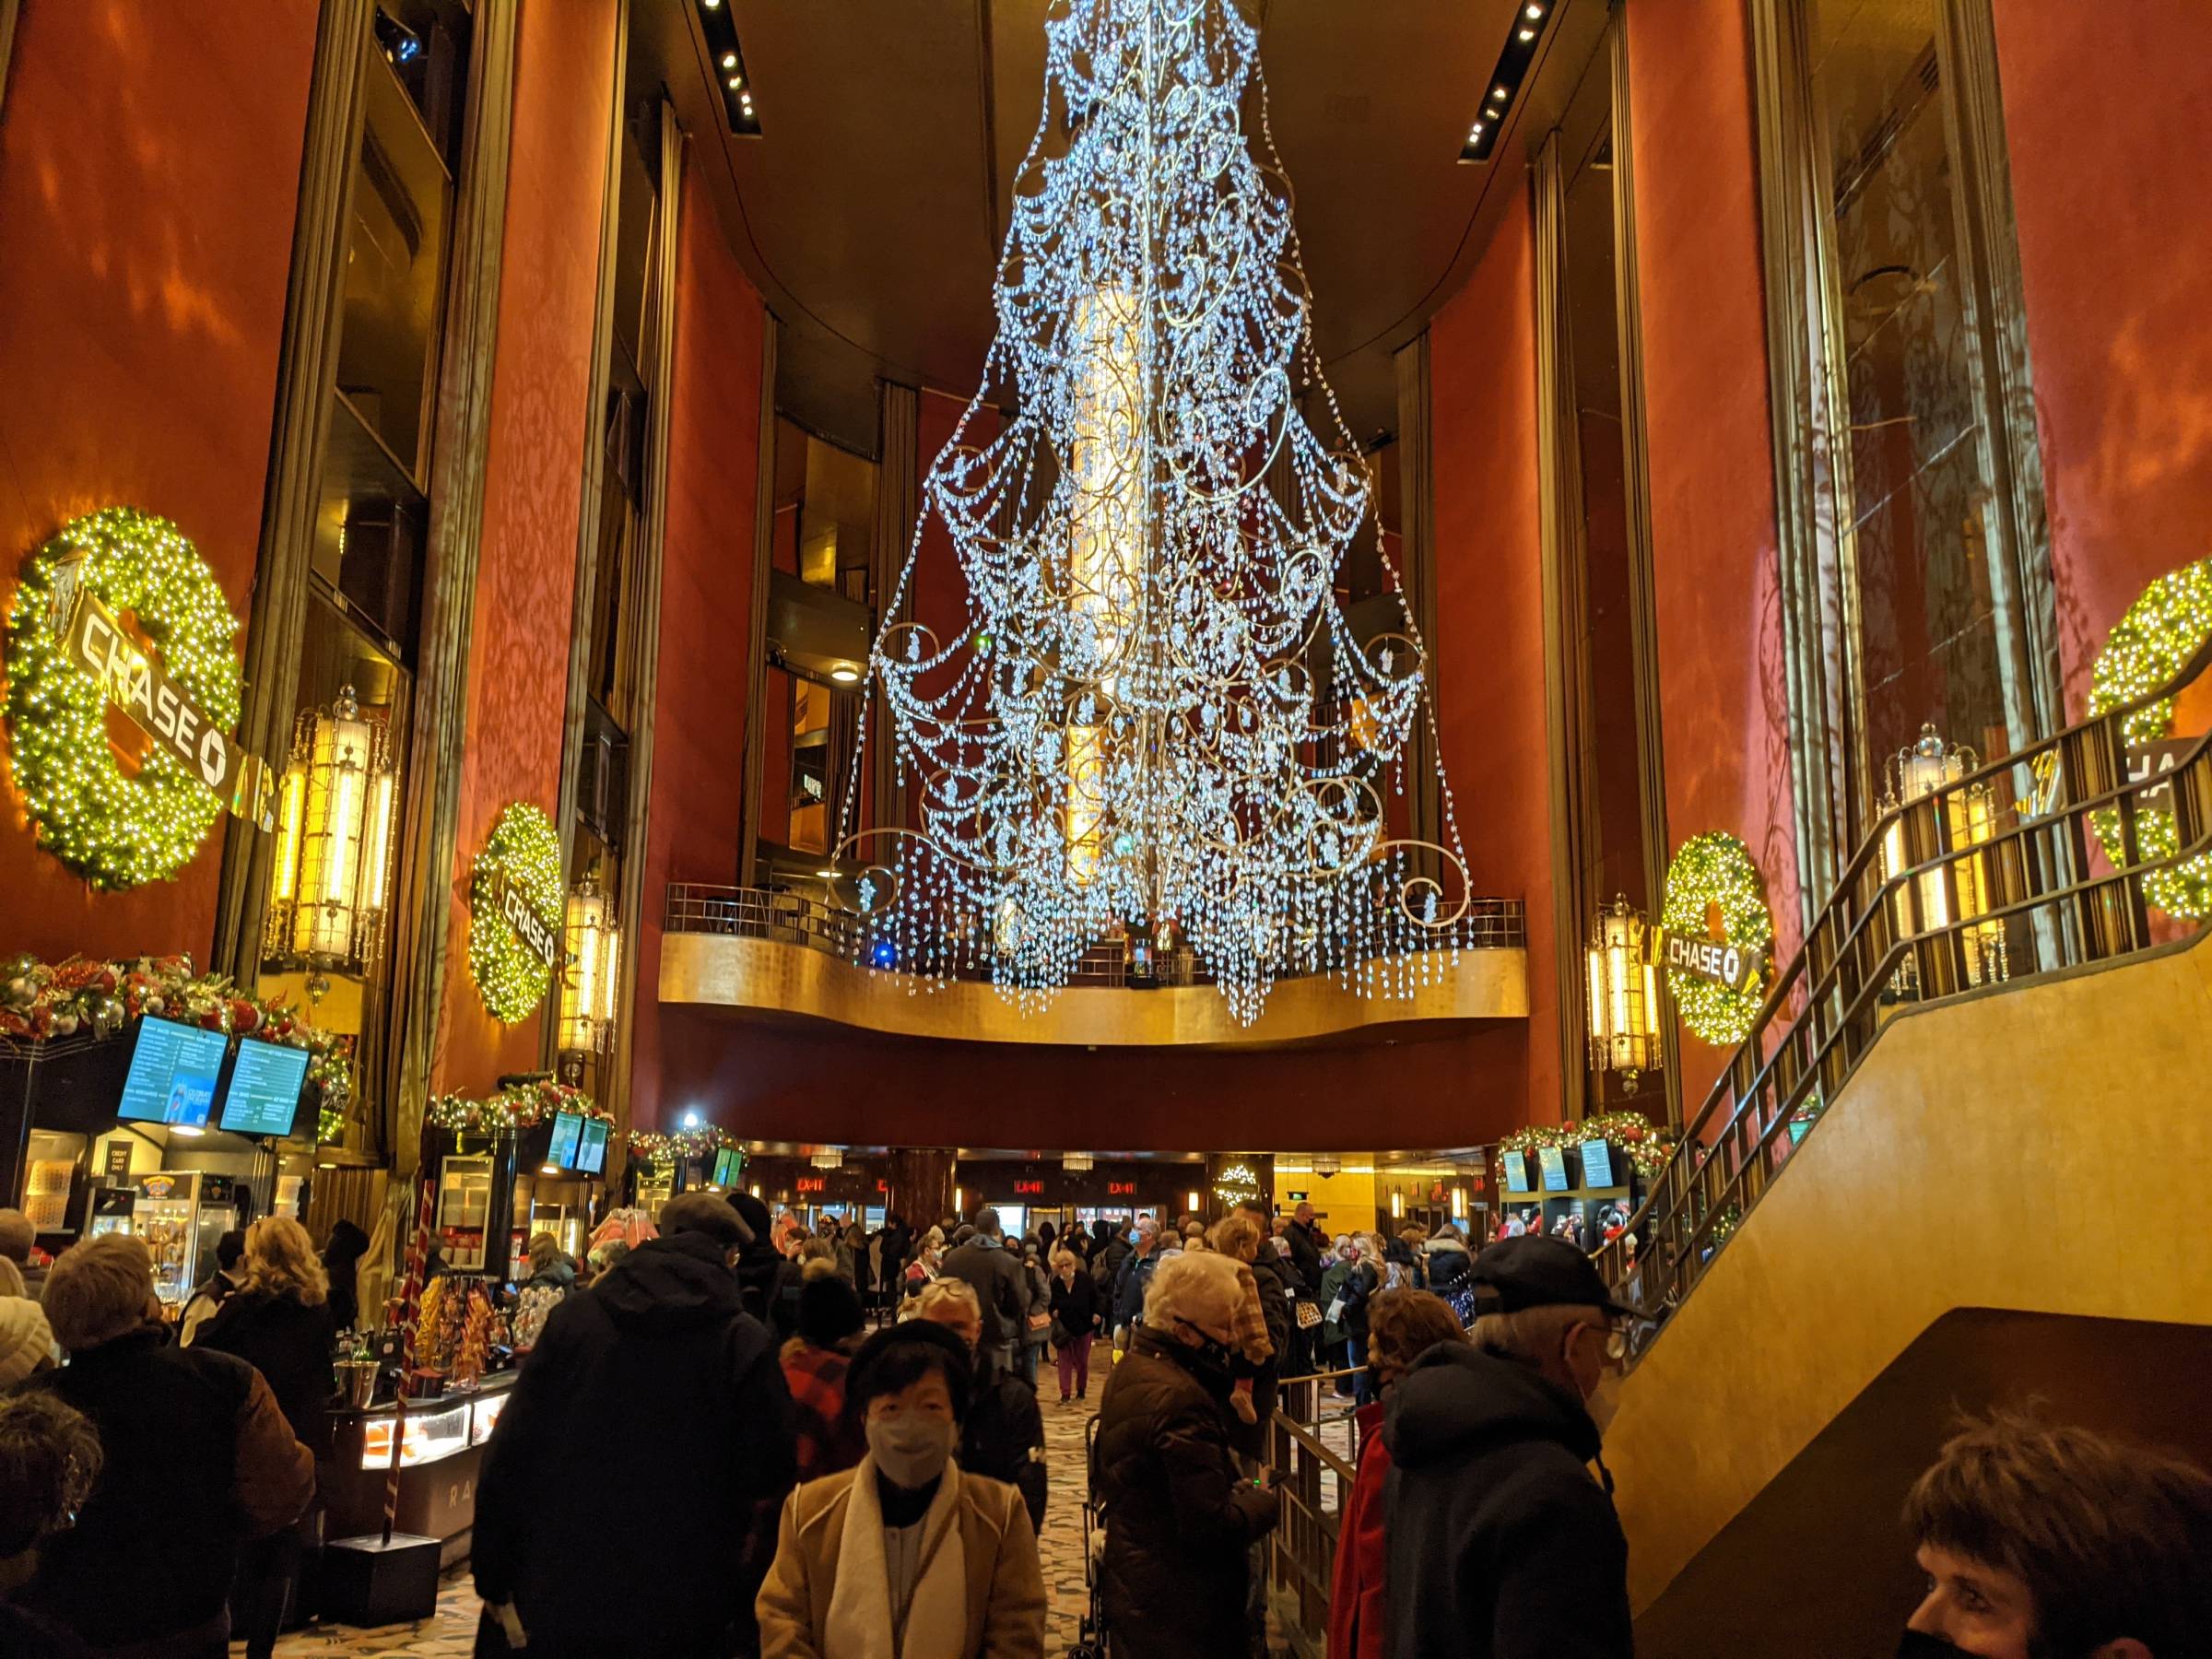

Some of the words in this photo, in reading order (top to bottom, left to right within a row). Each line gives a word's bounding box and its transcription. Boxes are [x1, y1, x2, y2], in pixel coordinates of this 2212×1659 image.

[82, 613, 199, 760] CHASE
[504, 888, 546, 956] CHASE
[1669, 937, 1723, 976] CHASE
[797, 1178, 824, 1191] EXIT
[1109, 1182, 1134, 1194] EXIT
[449, 1479, 471, 1508] RA
